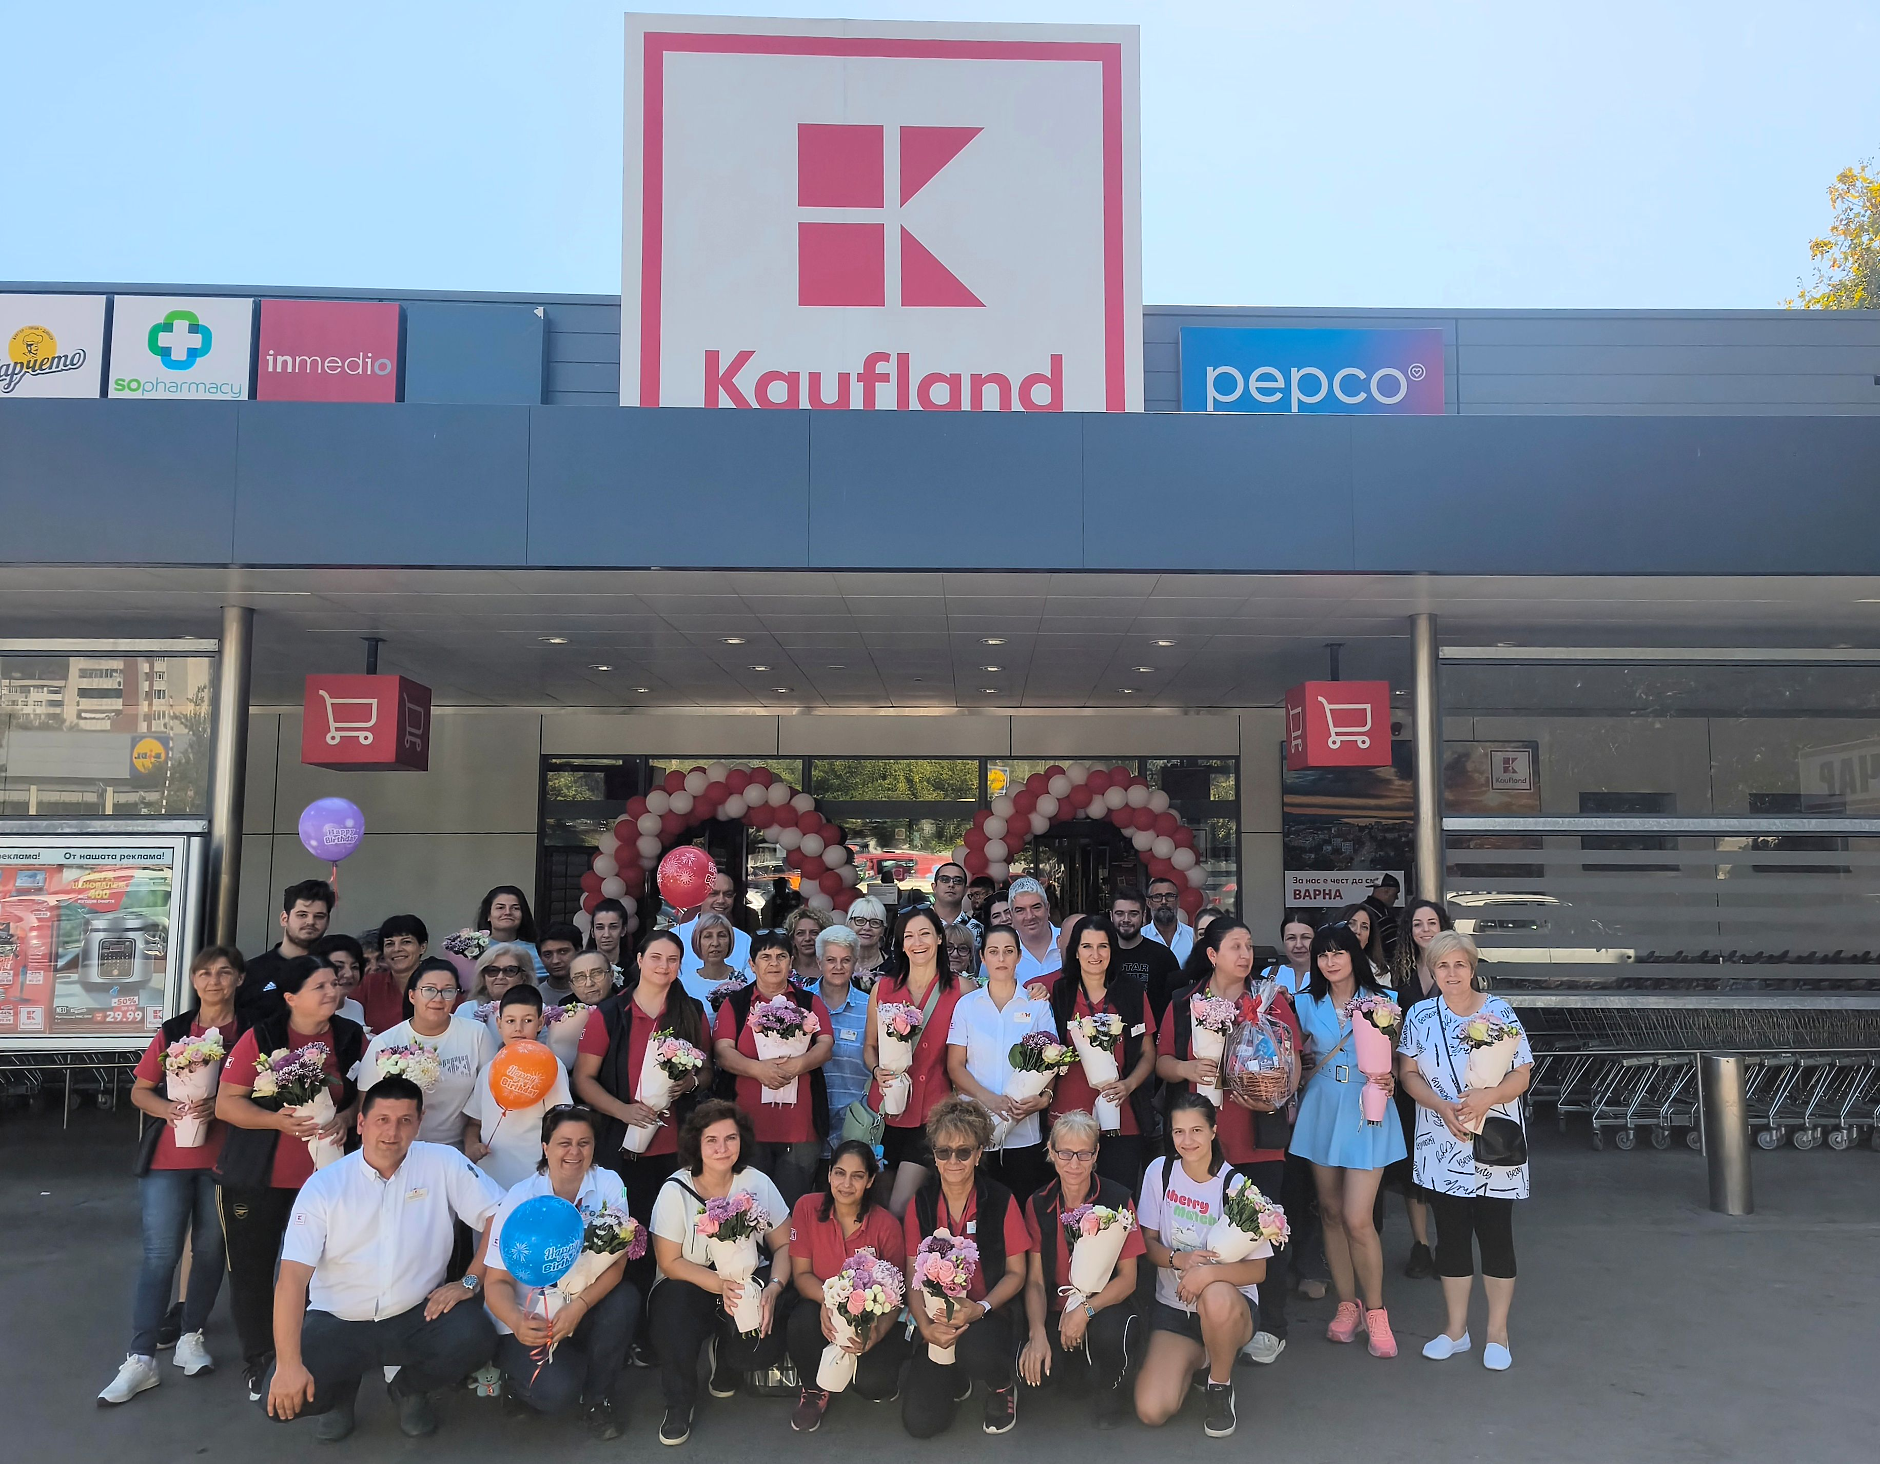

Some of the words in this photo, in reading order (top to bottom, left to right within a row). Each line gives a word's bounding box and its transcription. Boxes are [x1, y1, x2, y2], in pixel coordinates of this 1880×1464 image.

[266, 349, 392, 375] inmedio
[113, 377, 242, 398] sopharmacy
[703, 350, 1064, 412] Kaufland
[1206, 365, 1408, 413] pepco
[323, 834, 358, 845] Birthday
[63, 852, 77, 860] От
[119, 852, 165, 861] реклама!
[1292, 876, 1303, 884] За
[1293, 888, 1343, 900] ВАРНА
[106, 1012, 142, 1022] 29.99
[507, 1065, 538, 1088] Happy
[501, 1077, 539, 1098] Birthday
